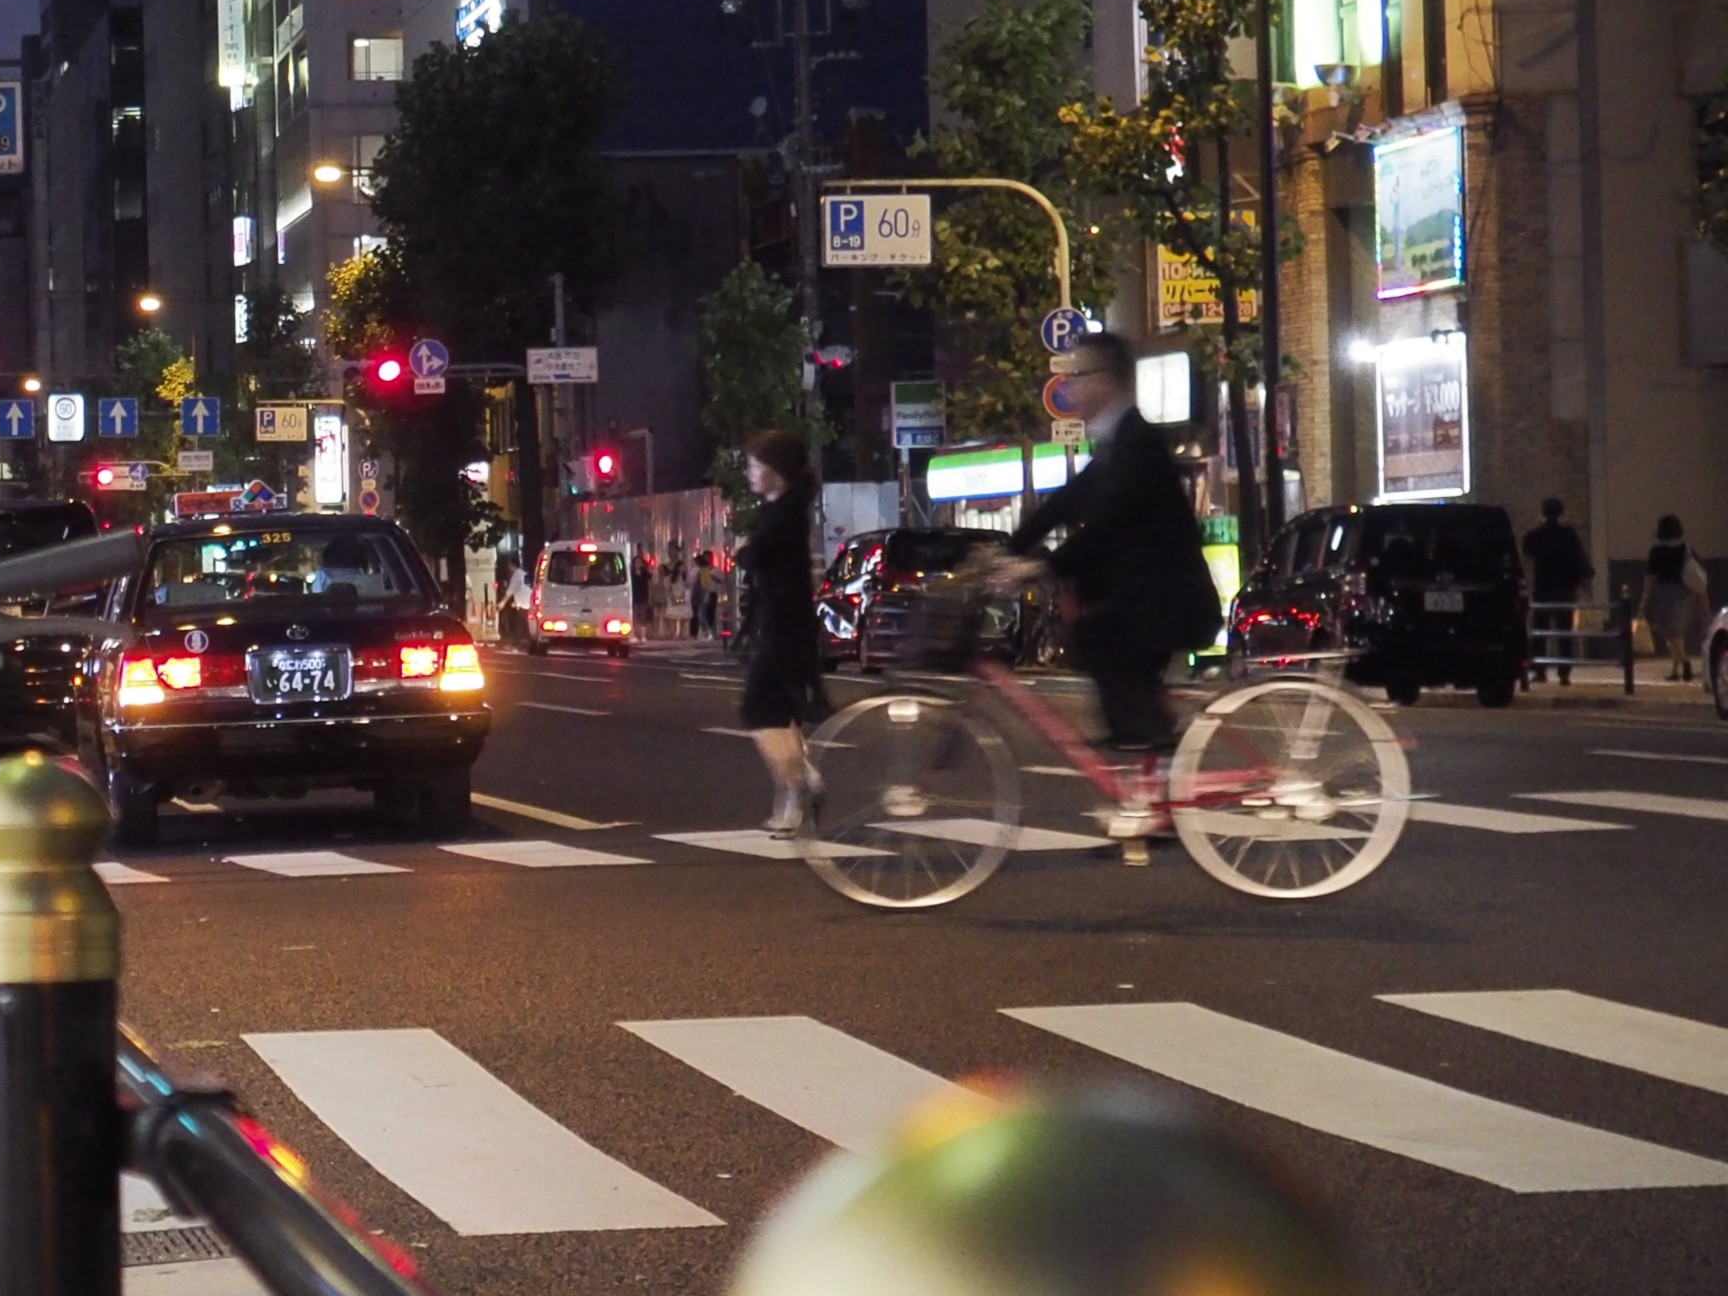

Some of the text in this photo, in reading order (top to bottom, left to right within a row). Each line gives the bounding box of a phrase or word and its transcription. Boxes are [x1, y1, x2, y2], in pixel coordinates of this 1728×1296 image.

[840, 204, 858, 233] P
[832, 236, 861, 248] 8-19
[1052, 318, 1071, 349] P
[261, 532, 292, 543] 325
[279, 670, 335, 693] 64-74
